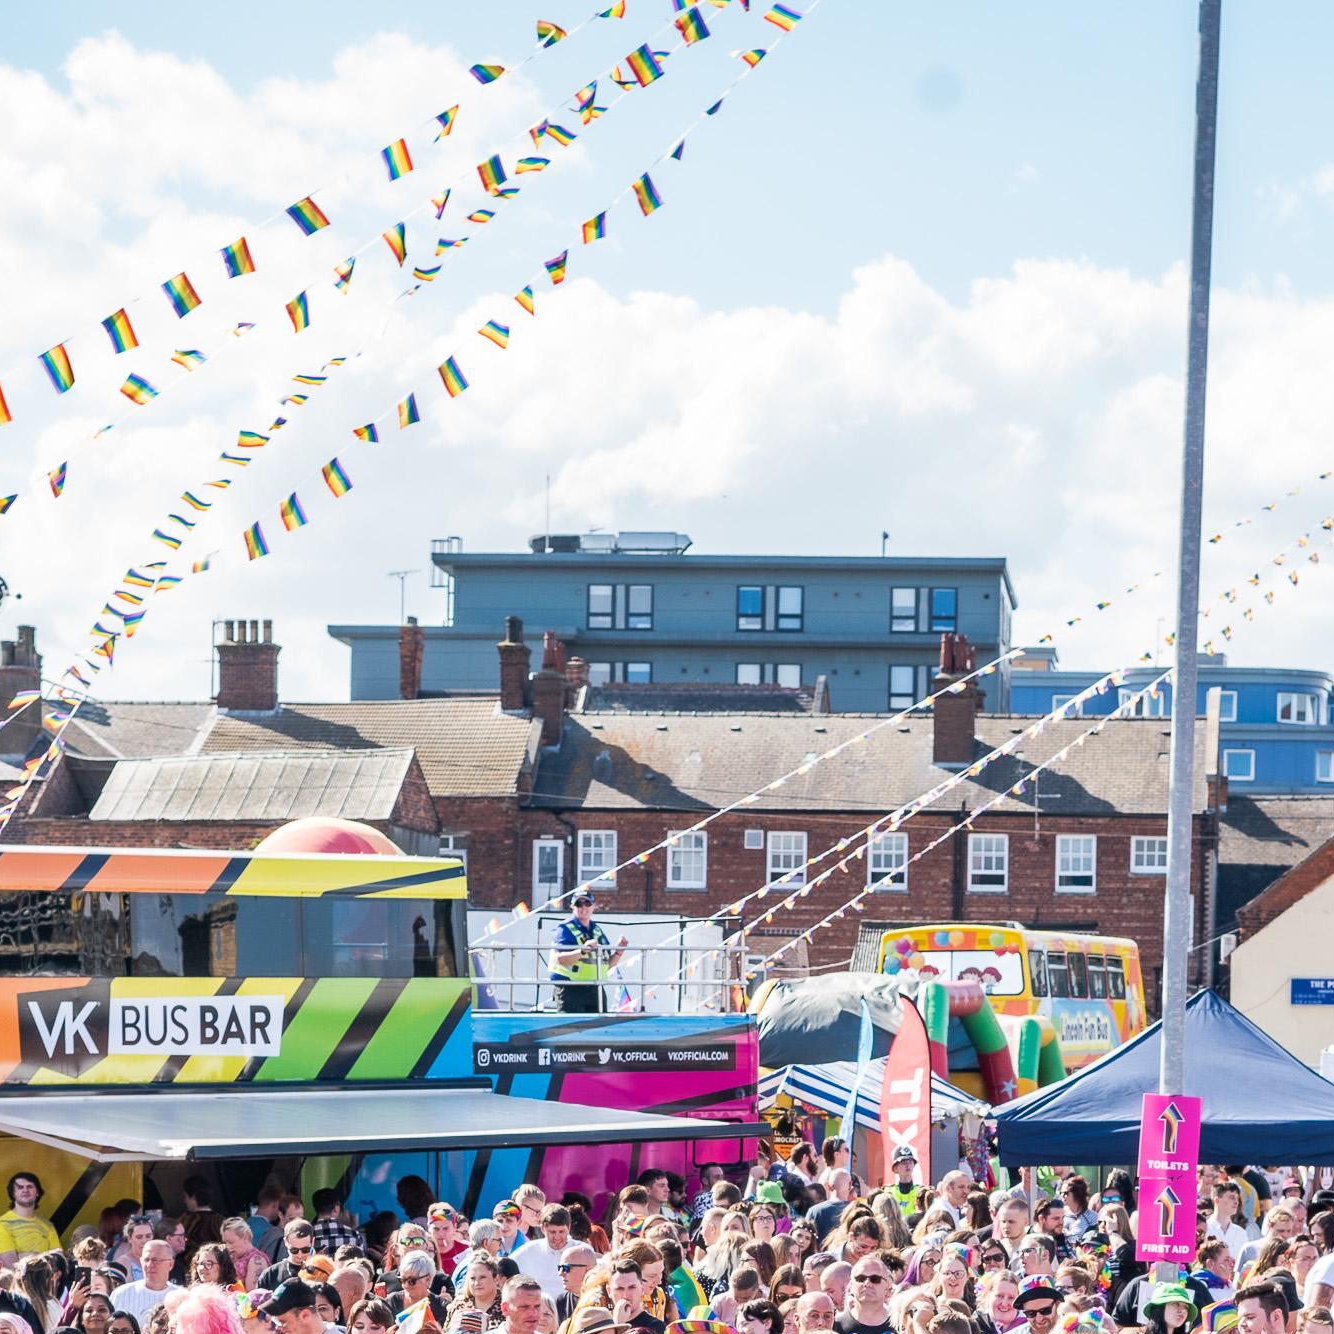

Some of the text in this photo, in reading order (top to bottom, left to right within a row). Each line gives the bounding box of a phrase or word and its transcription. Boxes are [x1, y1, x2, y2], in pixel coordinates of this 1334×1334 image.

[1310, 980, 1324, 988] THE
[28, 1001, 271, 1058] VK BUS BAR
[492, 1053, 528, 1064] VKDRINK
[552, 1051, 586, 1063] VKDRINK
[612, 1051, 658, 1063] VK_OFFICIAL
[667, 1050, 729, 1062] VKOFFICIAL.COM
[1147, 1160, 1189, 1171] TOILETS
[1142, 1244, 1189, 1254] FIRST AID
